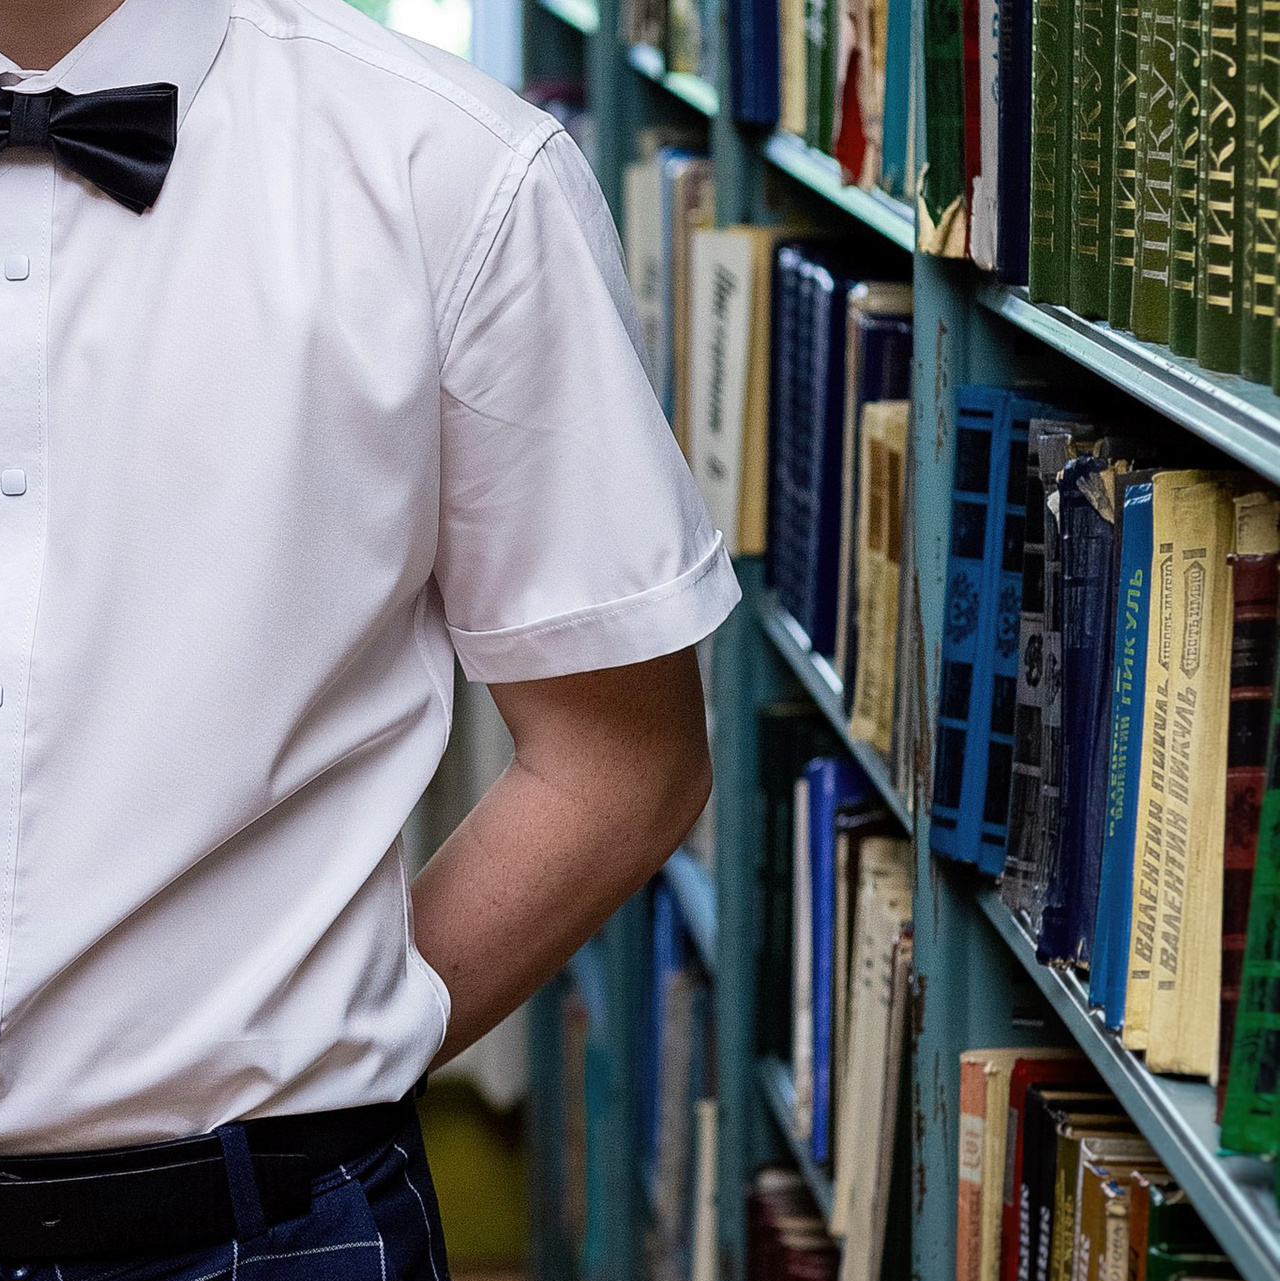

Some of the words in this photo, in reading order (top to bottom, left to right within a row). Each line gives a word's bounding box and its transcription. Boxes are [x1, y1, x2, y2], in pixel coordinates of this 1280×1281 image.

[1121, 568, 1143, 705] ПИКУЛЬ
[1185, 619, 1201, 668] ЧЕСТЬ
[1187, 569, 1203, 618] ИМЕЮ
[1167, 686, 1198, 806] ПИКУЛЬ
[1134, 799, 1164, 964] ВАЛЕНТИН
[1158, 808, 1188, 975] ВАЛЕНТИН
